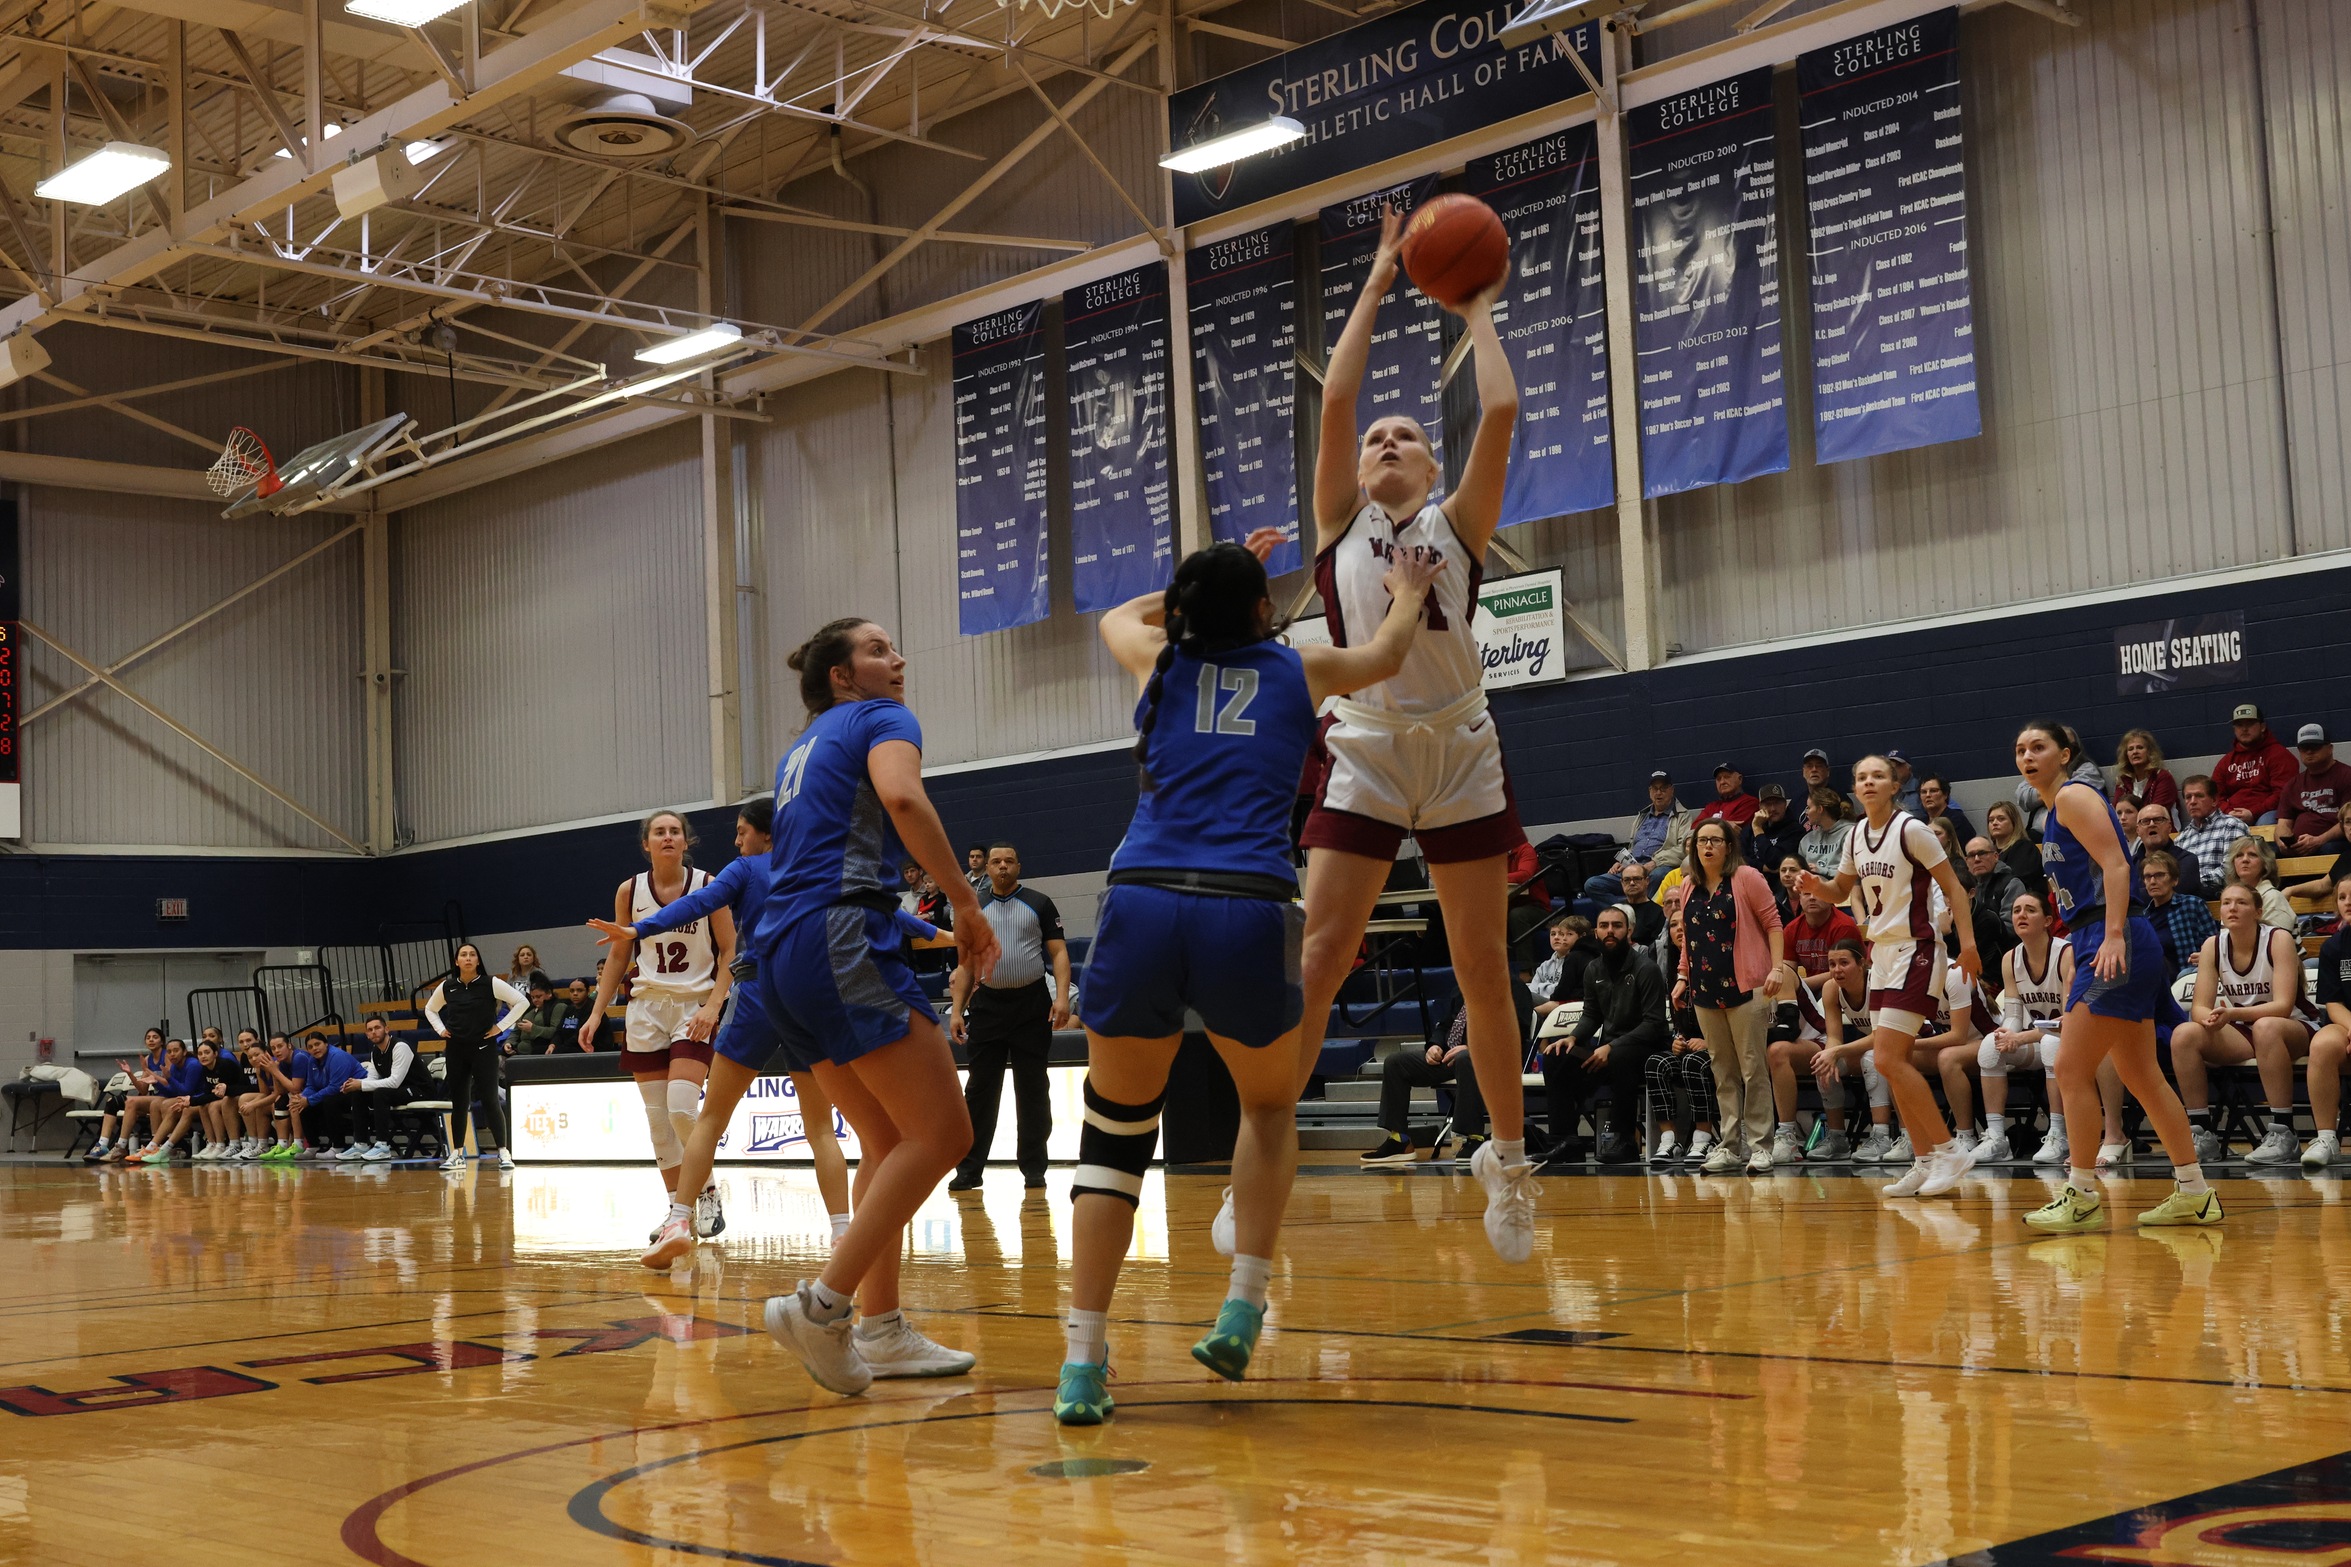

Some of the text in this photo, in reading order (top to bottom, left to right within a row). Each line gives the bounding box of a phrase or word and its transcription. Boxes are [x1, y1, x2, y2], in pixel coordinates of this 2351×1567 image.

[1833, 24, 1919, 64] STERLING
[1268, 0, 1531, 120] STERLING COLL
[1834, 38, 1920, 77] COLLEGE
[1400, 74, 1465, 114] HALL
[1474, 56, 1507, 87] OF
[1519, 27, 1588, 72] FAME
[1660, 80, 1738, 117] STERLING
[1842, 90, 1918, 120] INDUCTED 2014
[1660, 94, 1739, 130] COLLEGE
[1863, 121, 1899, 141] Class of 2004
[1494, 135, 1565, 169] STERLING
[1495, 148, 1566, 181] COLLEGE
[1668, 143, 1737, 172] INDUCTED 2010
[1865, 155, 1879, 168] Class
[1880, 153, 1885, 164] of
[1898, 174, 1911, 187] First
[1912, 170, 1927, 183] KCAC
[1346, 186, 1410, 216] STERLING
[1501, 194, 1566, 221] INDUCTED 2002
[1824, 194, 1838, 208] Cross
[1838, 189, 1858, 204] Country
[1858, 186, 1871, 198] Team
[1899, 202, 1913, 215] First
[1913, 198, 1929, 211] KCAC
[1347, 198, 1411, 228] COLLGE
[1848, 216, 1862, 229] Track
[1862, 215, 1866, 225] &
[1866, 211, 1879, 224] Field
[1879, 208, 1892, 220] Team
[1209, 230, 1268, 259] STERLING
[1850, 222, 1926, 249] INDUCTED 2016
[1210, 242, 1269, 270] COLLEGE
[1875, 257, 1890, 270] Class
[1890, 256, 1896, 266] of
[1085, 271, 1139, 298] STERLING
[1877, 285, 1891, 298] Class
[1892, 284, 1897, 294] of
[1919, 273, 1943, 288] Women's
[1086, 283, 1140, 309] COLLEGE
[1215, 284, 1267, 307] INDUCTED 1996
[1878, 308, 1915, 326] Class of 2007
[1919, 301, 1945, 316] Women's
[972, 309, 1022, 334] STERLING
[972, 320, 1022, 345] COLLEGE
[1090, 323, 1138, 344] INDUCTED 1994
[1507, 314, 1573, 339] INDUCTED 2006
[1815, 328, 1827, 340] K.C.
[1677, 325, 1747, 350] INDUCTED 2012
[1880, 340, 1894, 353] Class
[1895, 339, 1901, 350] of
[978, 358, 1021, 378] INDUCTED 1992
[1695, 359, 1709, 372] Class
[1909, 363, 1923, 375] First
[1923, 359, 1939, 373] KCAC
[1524, 385, 1538, 396] Class
[1697, 386, 1710, 398] Class
[1818, 368, 1897, 395] 1992-93 Men's Basketball Team
[1910, 391, 1924, 403] First
[1924, 387, 1940, 400] KCAC
[1713, 409, 1725, 420] First
[1726, 406, 1742, 419] KCAC
[1820, 395, 1905, 422] 1992-93 Women's Basketball Team
[1674, 417, 1692, 429] Soccer
[1693, 414, 1704, 426] Team
[1493, 591, 1548, 611] PINNACLE
[1492, 620, 1555, 636] SPORTS PERFORMANCE
[1505, 613, 1548, 625] REHABILITATION
[1477, 633, 1551, 676] terling
[2119, 630, 2242, 675] HOME SEATING
[1195, 663, 1259, 736] 12
[777, 735, 818, 813] 21
[166, 901, 185, 916] EXIT
[655, 941, 690, 973] 12
